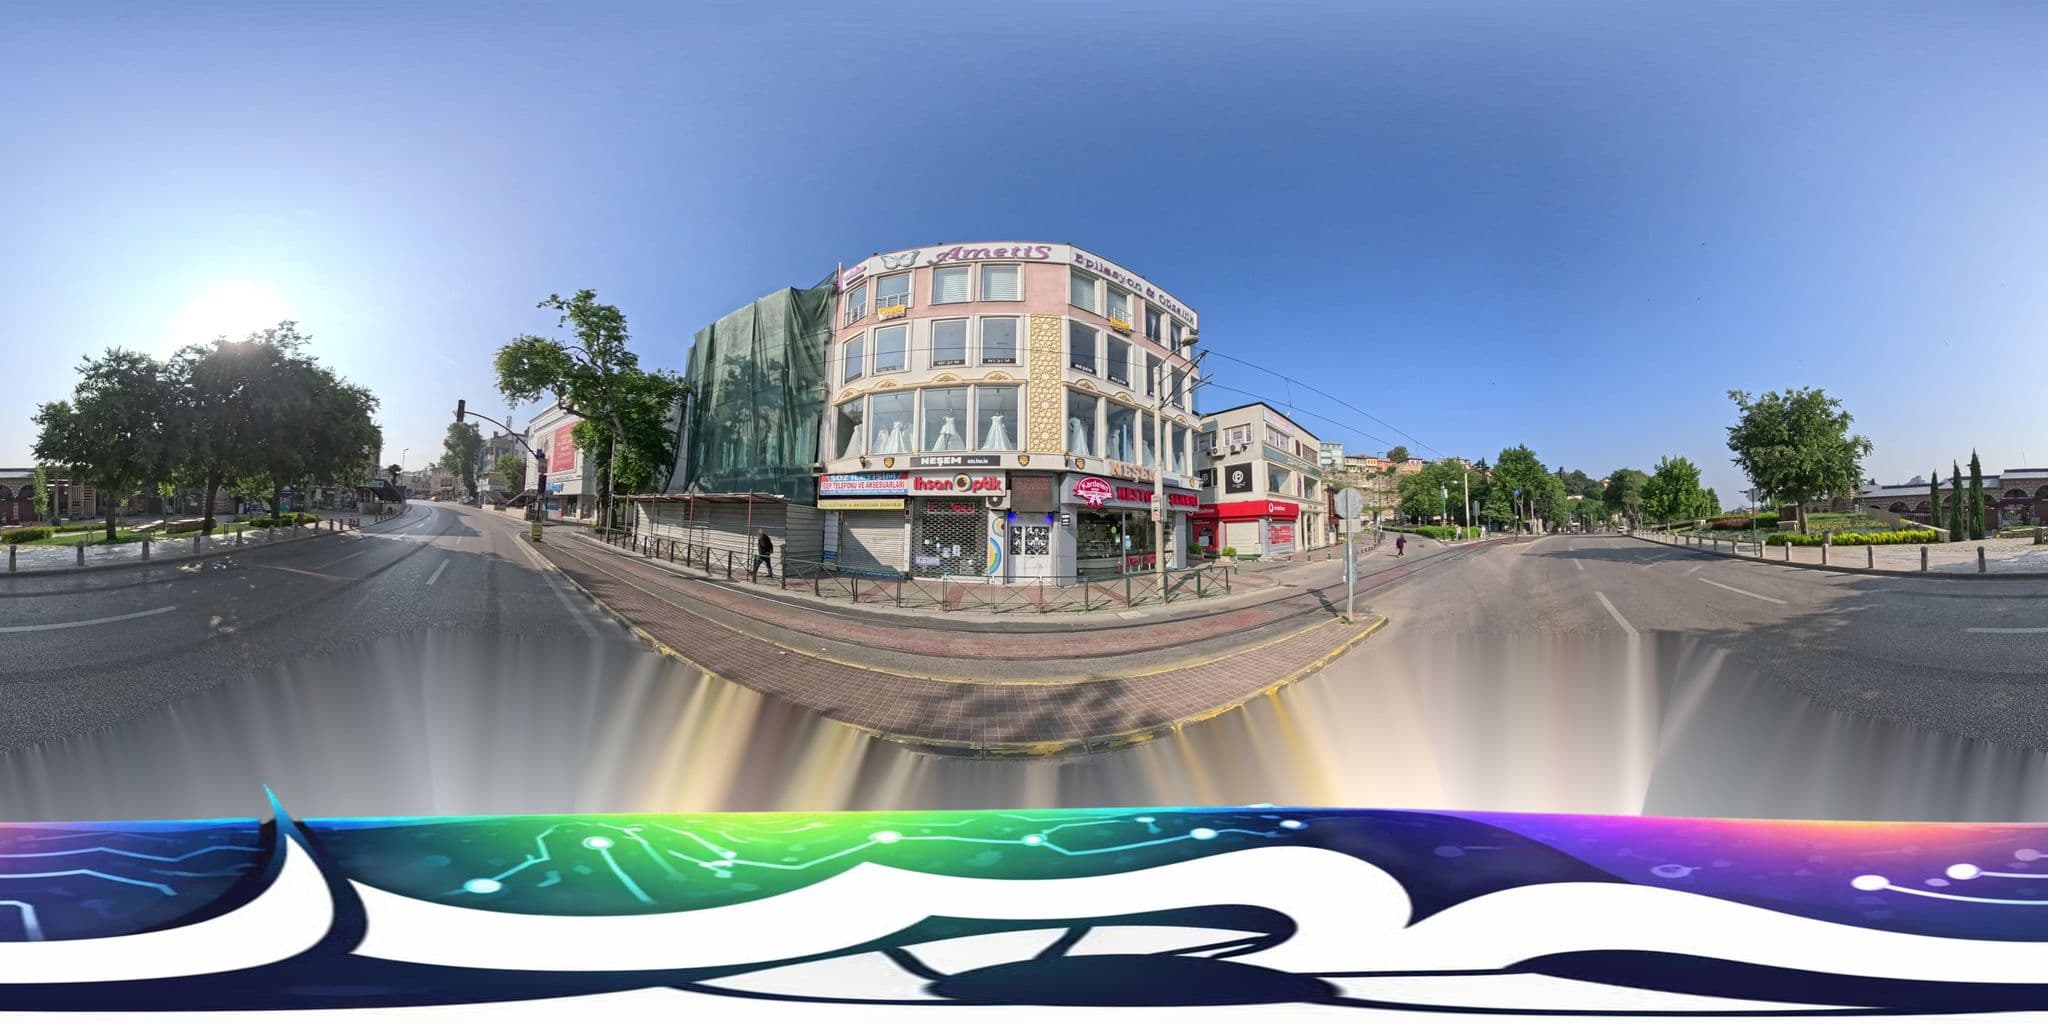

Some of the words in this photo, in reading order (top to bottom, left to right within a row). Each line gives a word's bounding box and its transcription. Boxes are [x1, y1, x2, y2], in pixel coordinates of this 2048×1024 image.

[1074, 252, 1143, 292] Epilasyon
[1145, 286, 1156, 300] &
[920, 456, 962, 466] NEŞEM
